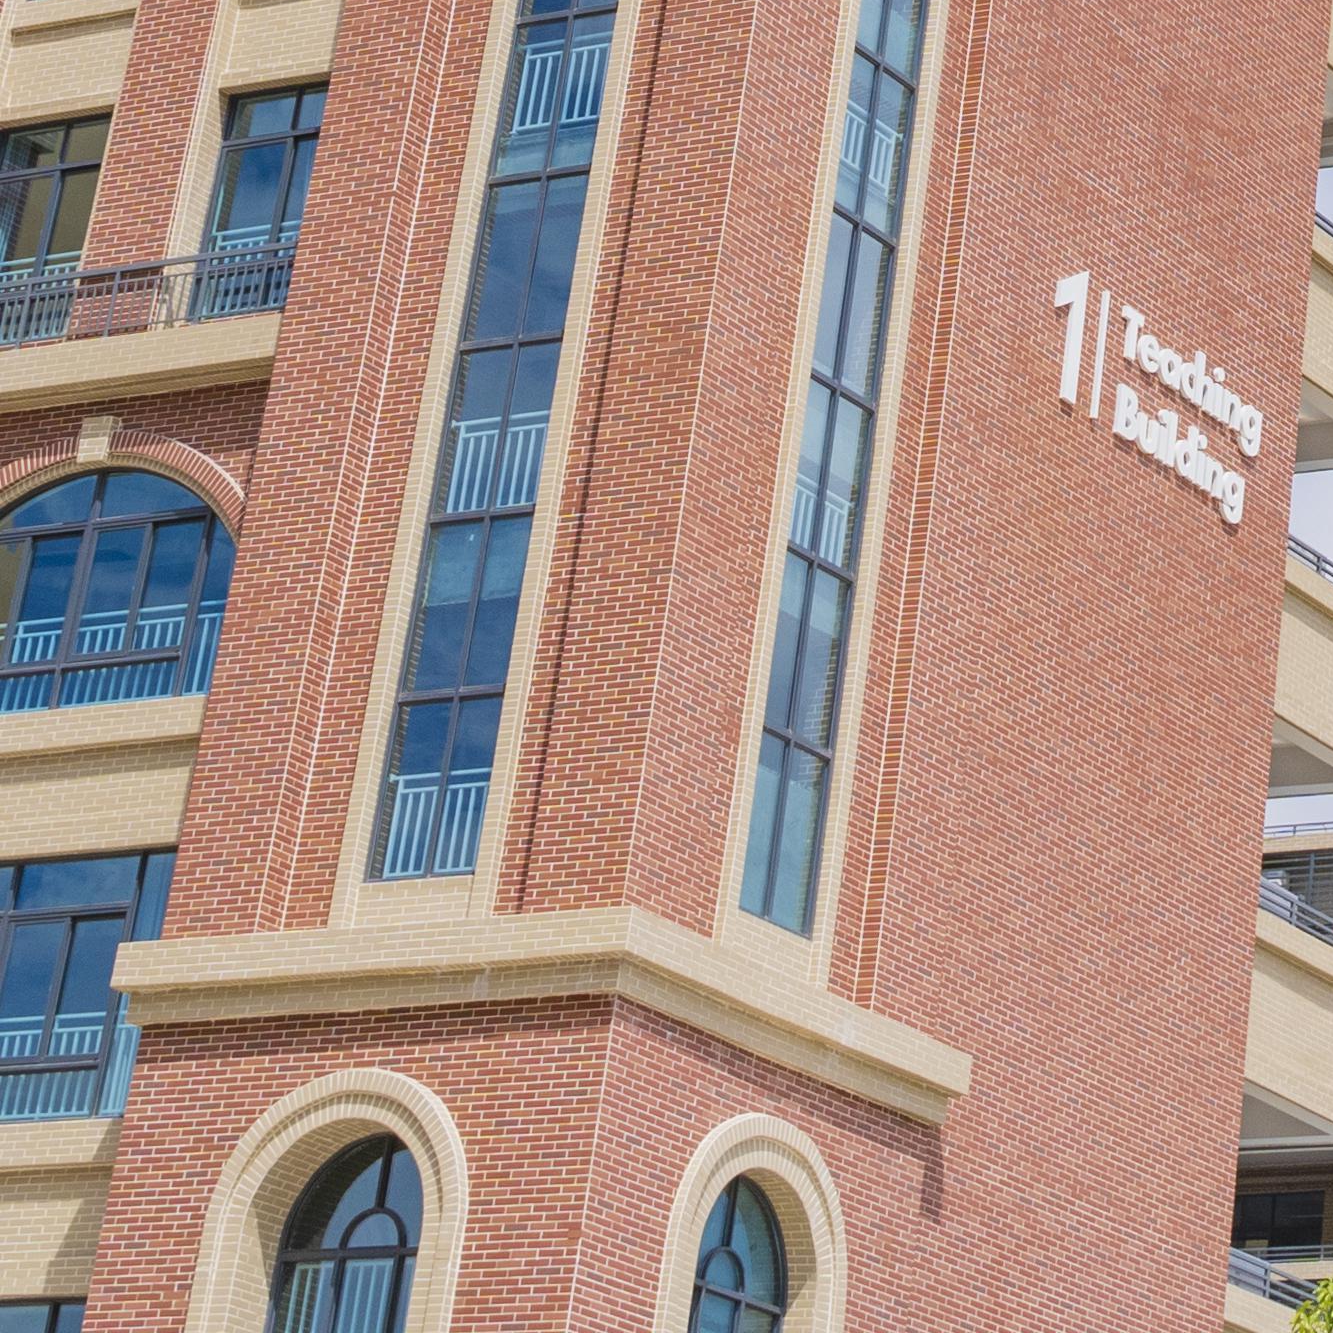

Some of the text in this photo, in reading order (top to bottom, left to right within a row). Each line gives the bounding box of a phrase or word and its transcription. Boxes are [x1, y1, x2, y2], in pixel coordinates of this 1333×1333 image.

[1054, 271, 1090, 405] 1
[1121, 305, 1264, 457] Teaching
[1112, 383, 1246, 524] Building
